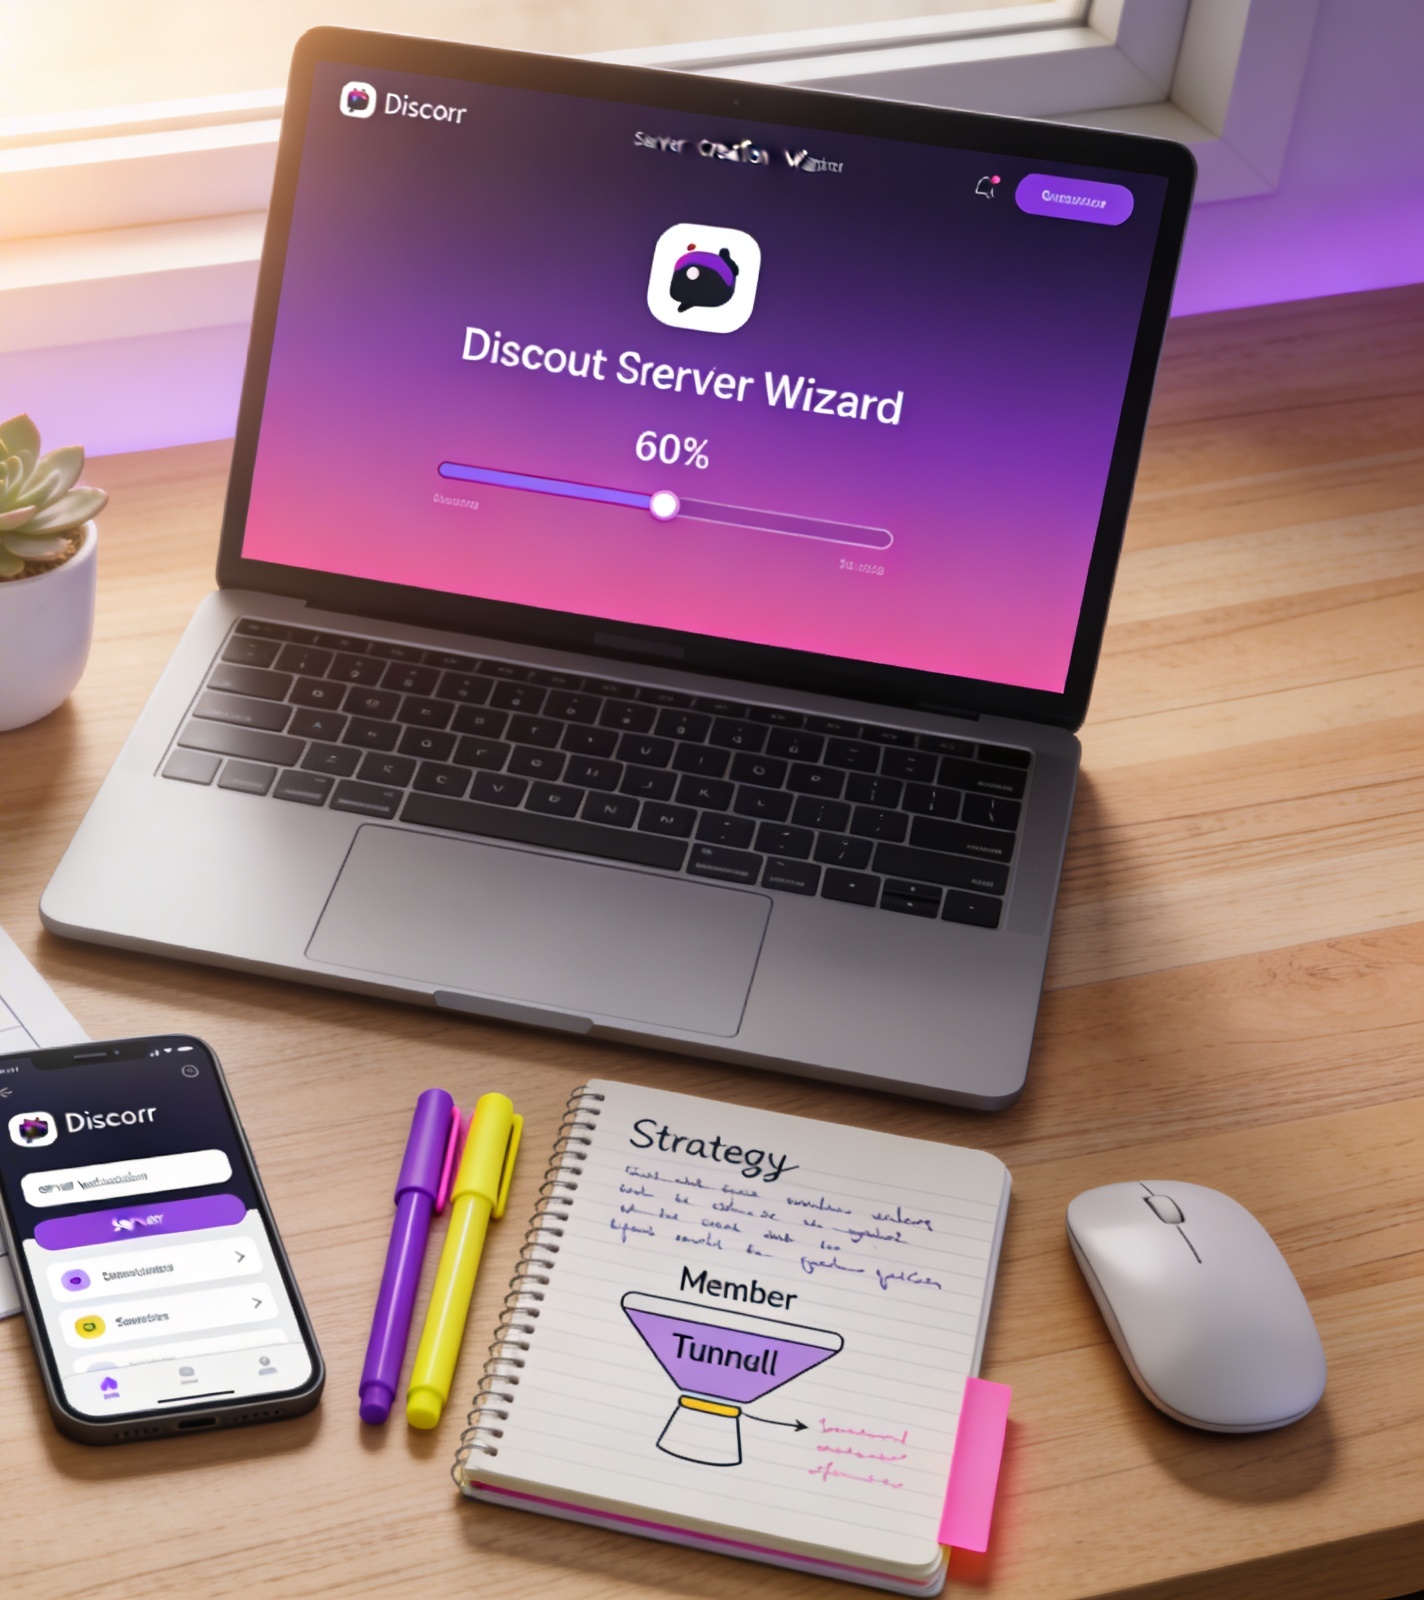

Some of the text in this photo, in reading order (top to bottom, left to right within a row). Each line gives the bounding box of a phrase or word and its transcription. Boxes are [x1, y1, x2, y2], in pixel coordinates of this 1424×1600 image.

[384, 92, 468, 124] Discorr
[461, 326, 905, 425] Discout Srerver Wizard
[634, 429, 710, 470] 60%
[64, 1107, 158, 1134] Discorr
[629, 1118, 801, 1183] Strategy
[678, 1265, 798, 1311] Member
